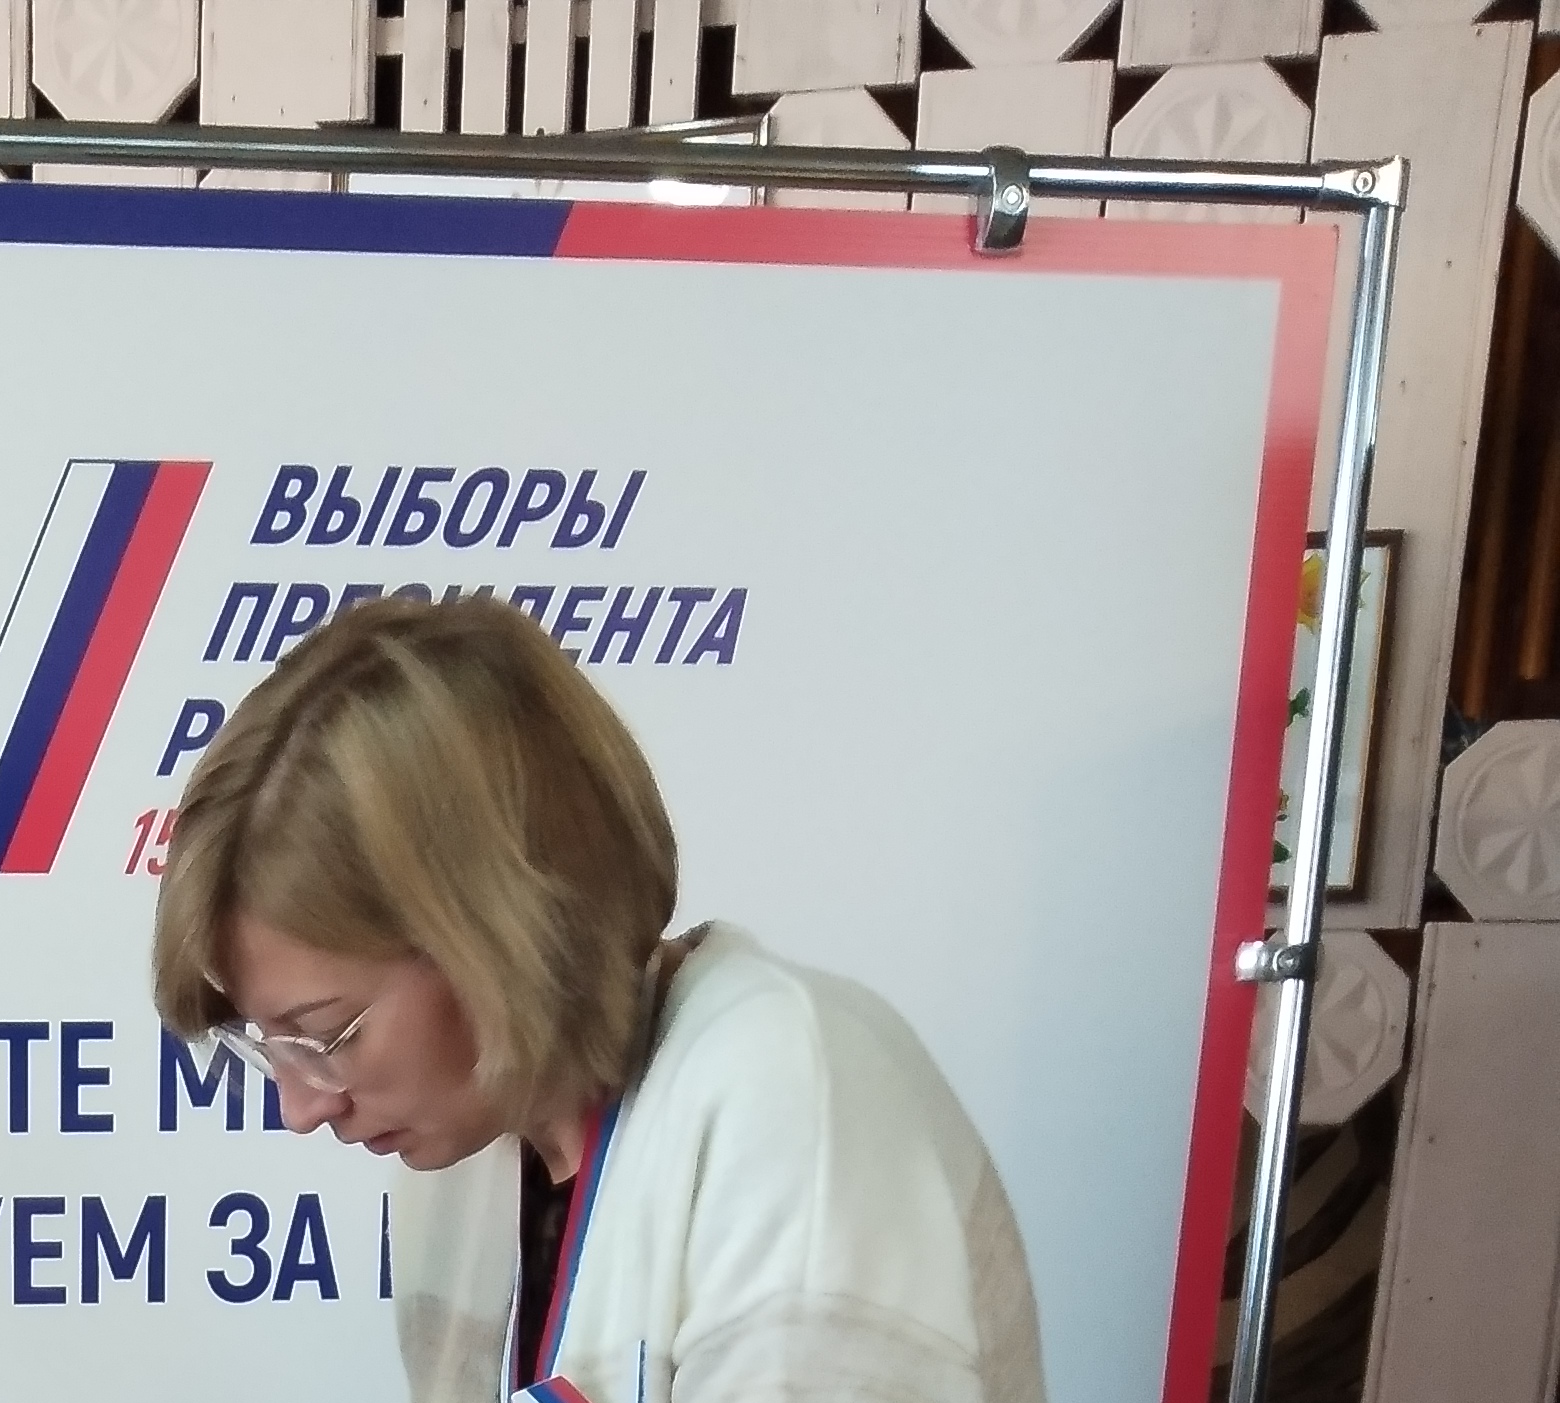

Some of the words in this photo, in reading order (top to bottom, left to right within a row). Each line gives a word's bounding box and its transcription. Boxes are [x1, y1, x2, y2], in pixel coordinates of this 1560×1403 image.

[251, 464, 647, 549] ВЫБОРЫ
[203, 582, 748, 665] ПРЕНТА
[206, 1192, 340, 1304] ЗА
